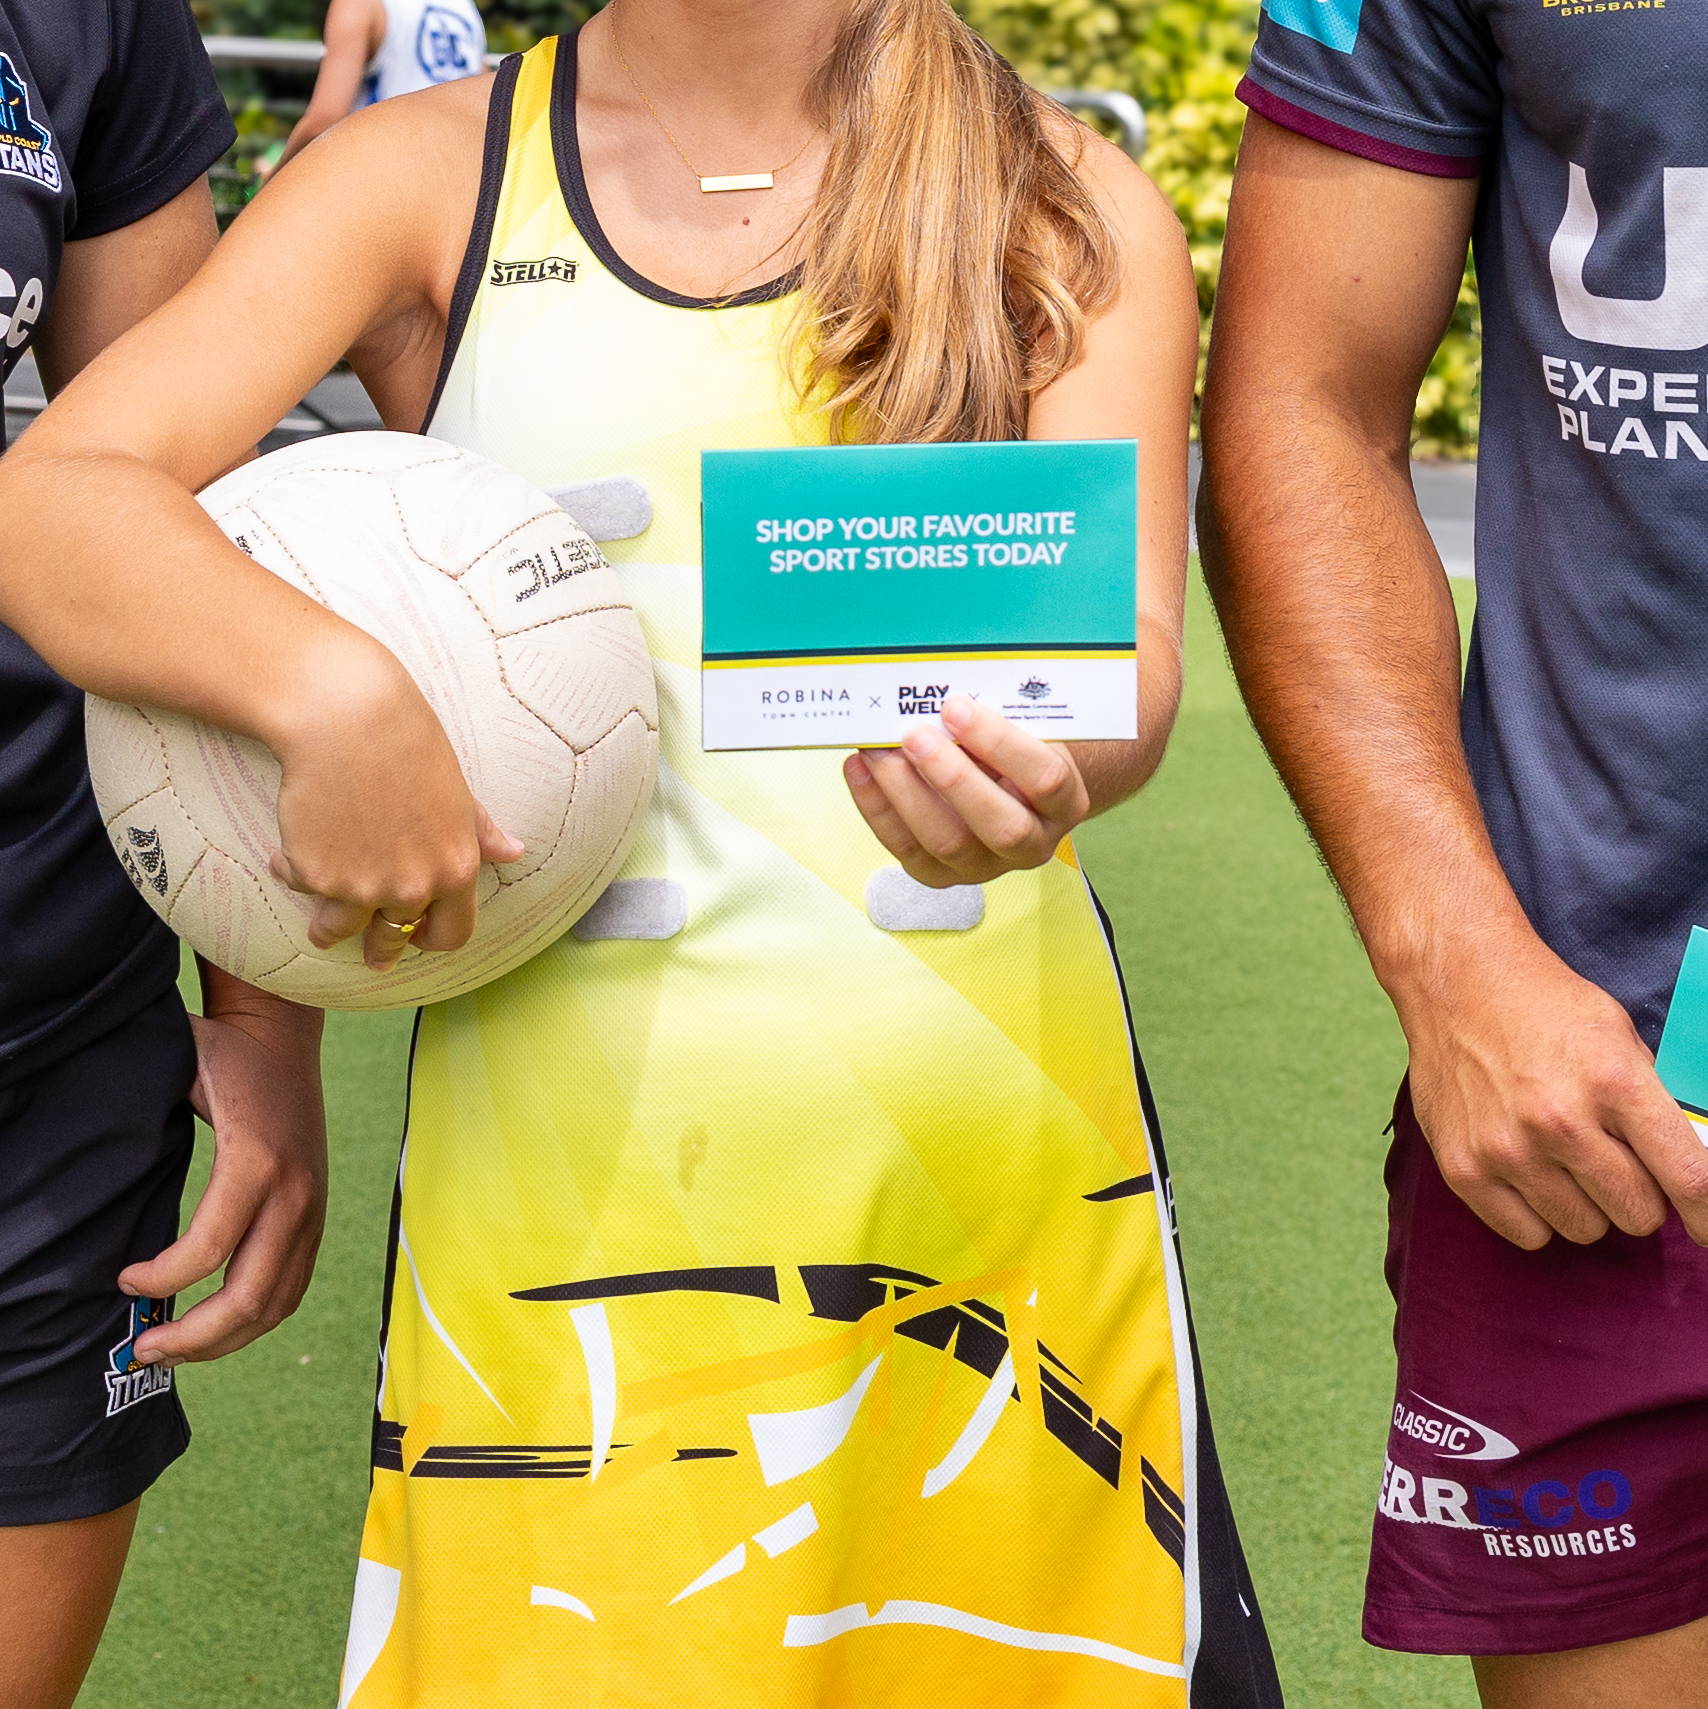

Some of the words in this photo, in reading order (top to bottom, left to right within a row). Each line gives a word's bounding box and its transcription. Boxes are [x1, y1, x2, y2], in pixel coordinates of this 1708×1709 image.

[1561, 0, 1666, 17] BRISBANE
[15, 136, 42, 151] COAST
[755, 518, 834, 543] SHOP
[838, 515, 917, 540] YOUR
[923, 511, 1076, 538] FAVOURITE
[769, 547, 861, 573] SPORT
[864, 543, 969, 570] STORES
[972, 541, 1068, 567] TODAY
[762, 689, 851, 704] ROBINA
[898, 685, 949, 699] PLAY
[898, 701, 946, 715] WEL
[1393, 1403, 1471, 1451] CLASSIC
[1483, 1523, 1637, 1558] RESOURCES
